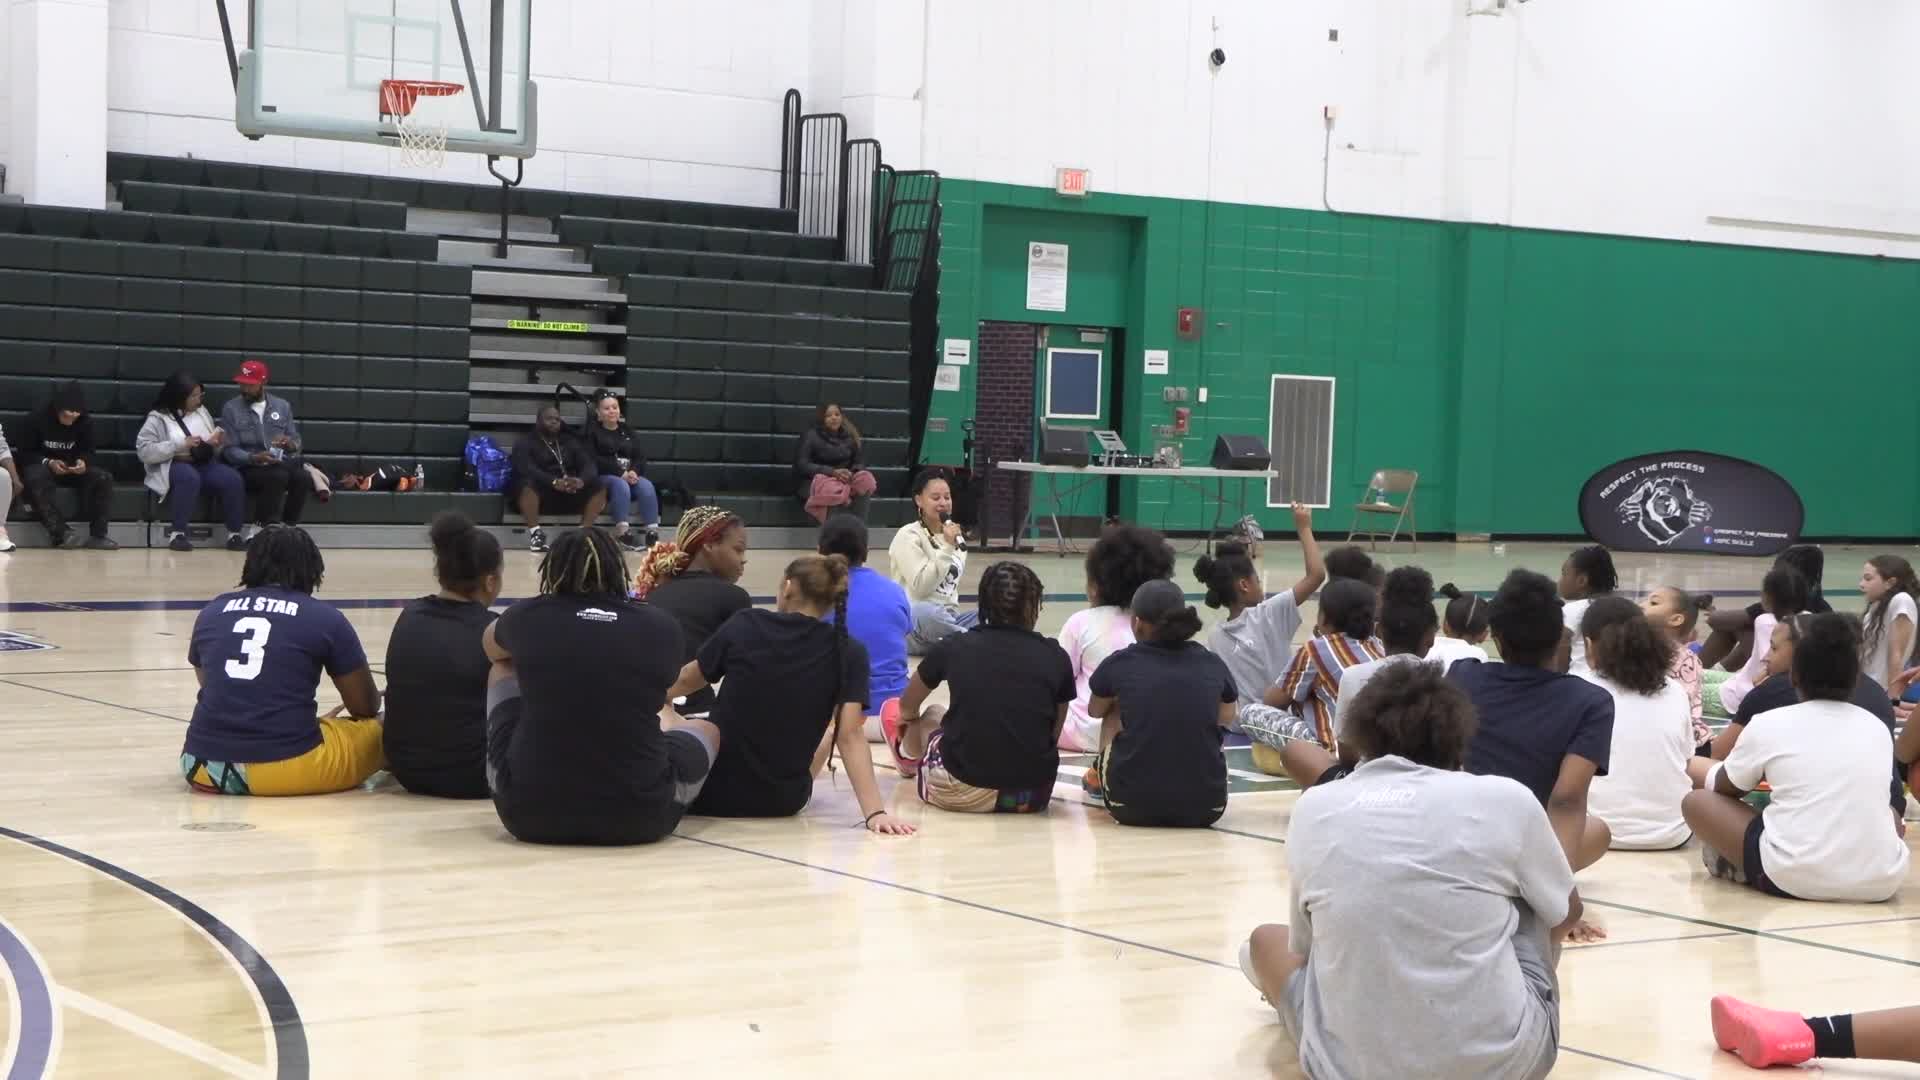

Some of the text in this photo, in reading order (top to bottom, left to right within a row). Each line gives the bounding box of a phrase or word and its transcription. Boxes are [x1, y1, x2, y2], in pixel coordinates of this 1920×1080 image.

[1064, 172, 1084, 191] EXIT
[563, 323, 580, 331] CLIMB
[1600, 461, 1705, 499] RESPECT THE PROCESS
[222, 596, 299, 616] ALL STAR
[224, 616, 272, 680] 3
